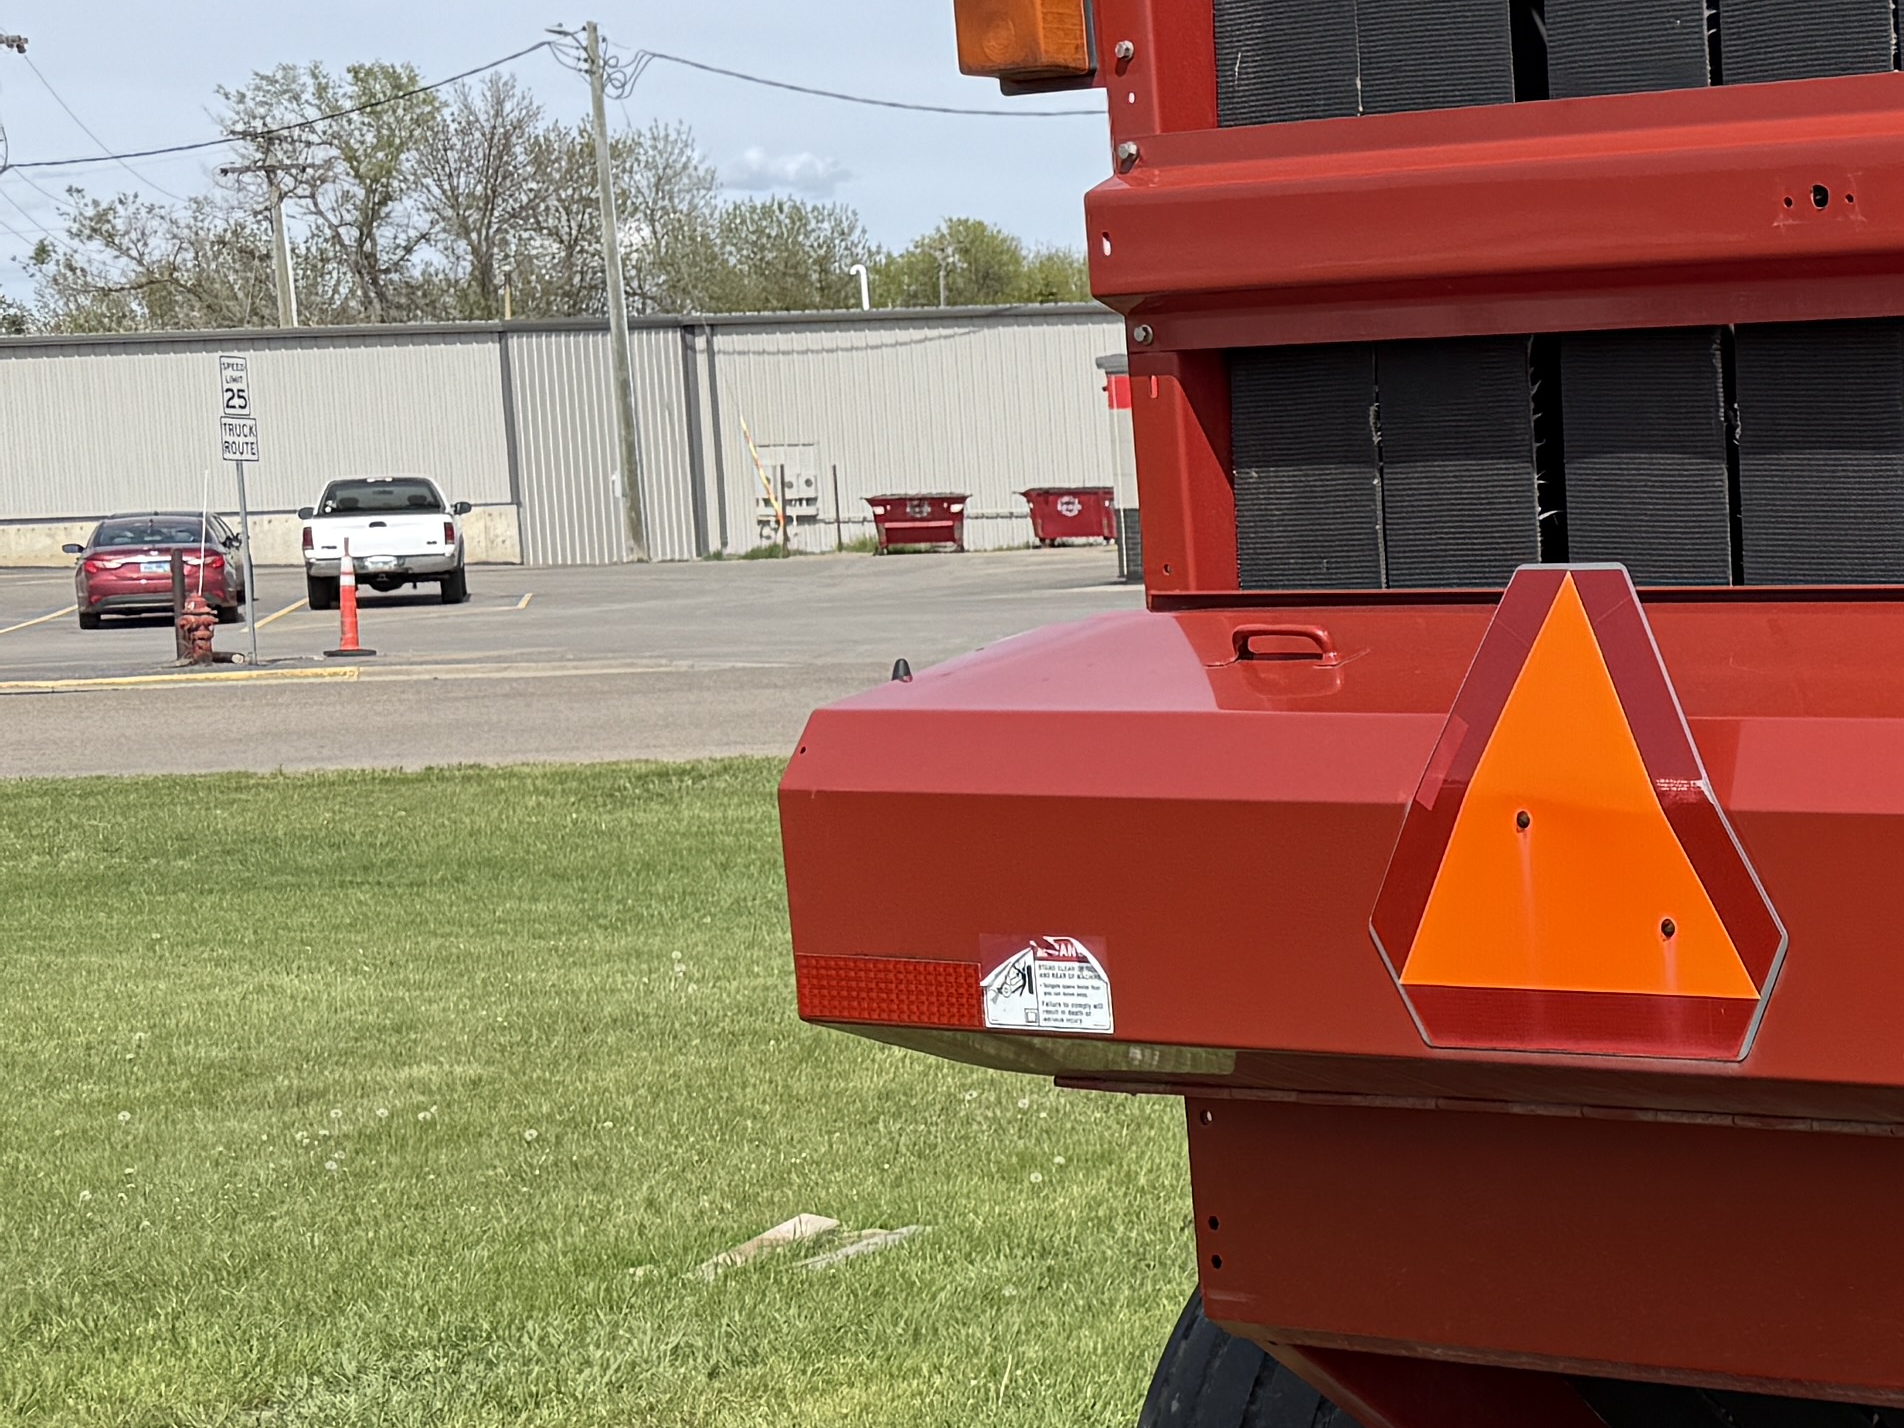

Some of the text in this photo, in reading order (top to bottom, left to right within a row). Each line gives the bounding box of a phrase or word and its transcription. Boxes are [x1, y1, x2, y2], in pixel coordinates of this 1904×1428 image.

[225, 388, 247, 409] 25
[223, 422, 256, 438] TRUCK
[224, 441, 256, 455] ROUTE
